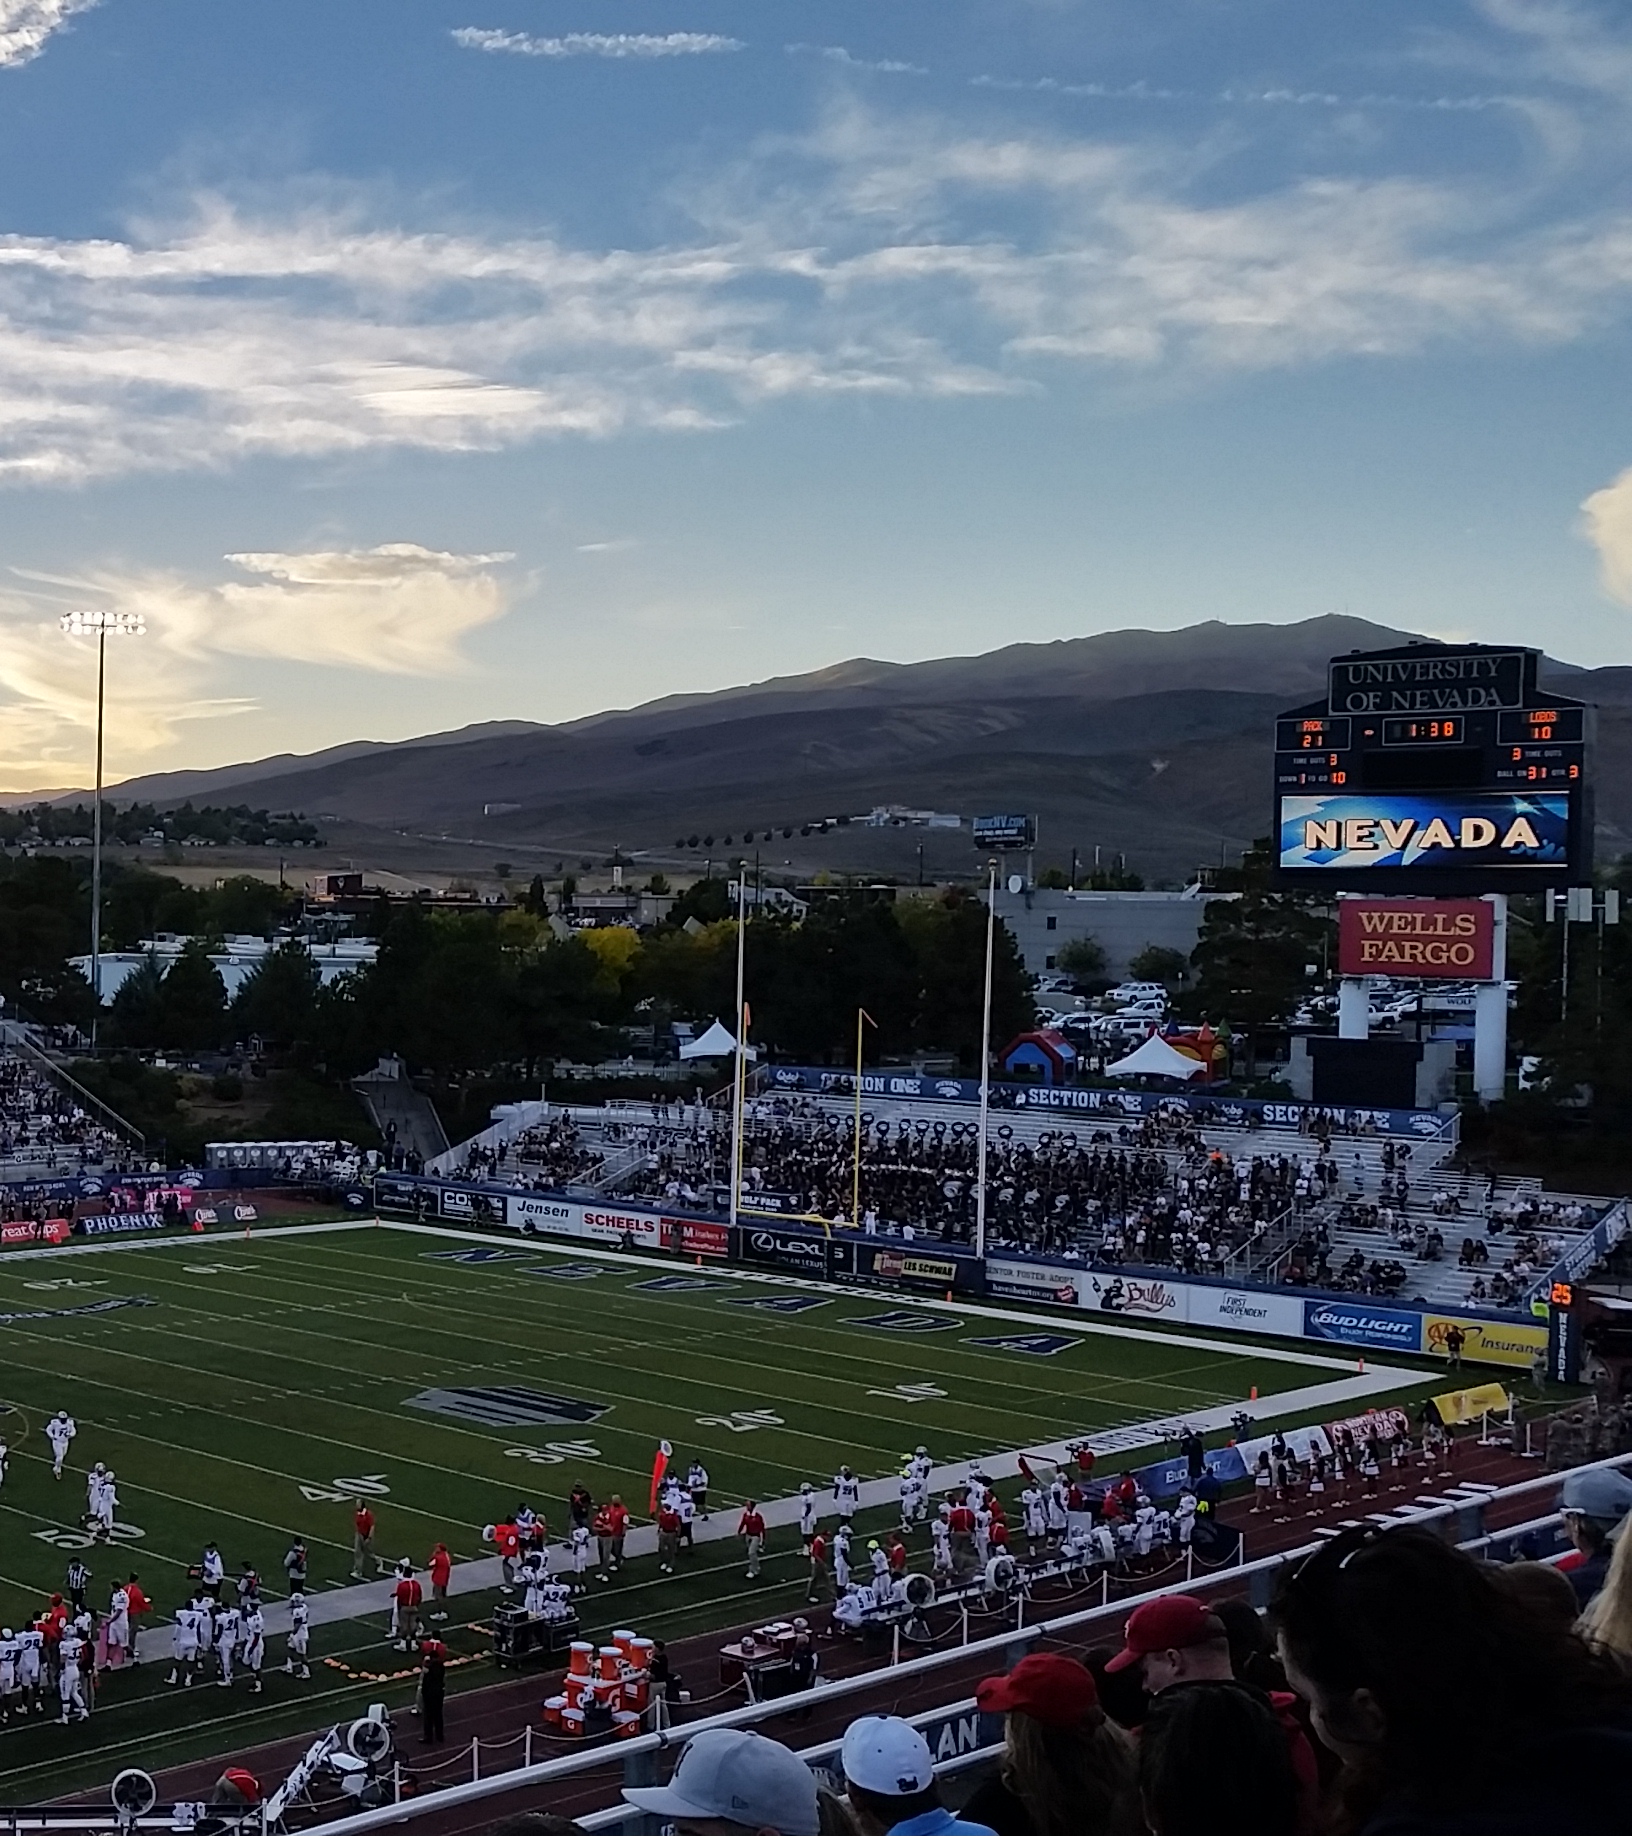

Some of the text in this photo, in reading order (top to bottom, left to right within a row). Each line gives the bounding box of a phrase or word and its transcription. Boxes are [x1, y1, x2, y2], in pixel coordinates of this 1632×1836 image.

[1348, 658, 1502, 684] UNIVERSITY
[1346, 687, 1502, 712] OF NEVADA
[1410, 722, 1454, 737] 1:38
[1531, 726, 1552, 739] 10
[1302, 735, 1323, 748] 21
[1329, 753, 1338, 766] 3
[1512, 747, 1522, 761] 3
[1330, 771, 1347, 785] 10
[1528, 765, 1547, 780] 31
[1569, 764, 1579, 779] 3
[1305, 817, 1540, 850] NEVADA
[1359, 912, 1476, 936] WELLS
[1360, 941, 1475, 966] FARGO
[890, 1078, 922, 1094] ONE
[1028, 1088, 1102, 1109] SECTION
[517, 1200, 569, 1218] Jensen
[2, 1224, 27, 1237] reat
[84, 1214, 163, 1234] PHOENIX
[584, 1212, 655, 1232] SCHEELS
[904, 1260, 954, 1277] LES SCHWAB
[1227, 1296, 1247, 1307] FIRST
[1219, 1305, 1268, 1318] INDEPENDENT
[1318, 1312, 1413, 1334] BUD LIGHT
[1557, 1312, 1569, 1382] NEVADA
[696, 1408, 786, 1433] 20
[505, 1439, 602, 1465] 30
[1164, 1468, 1188, 1485] BUD
[299, 1473, 392, 1503] 40
[566, 1719, 576, 1730] G
[627, 1721, 637, 1732] G
